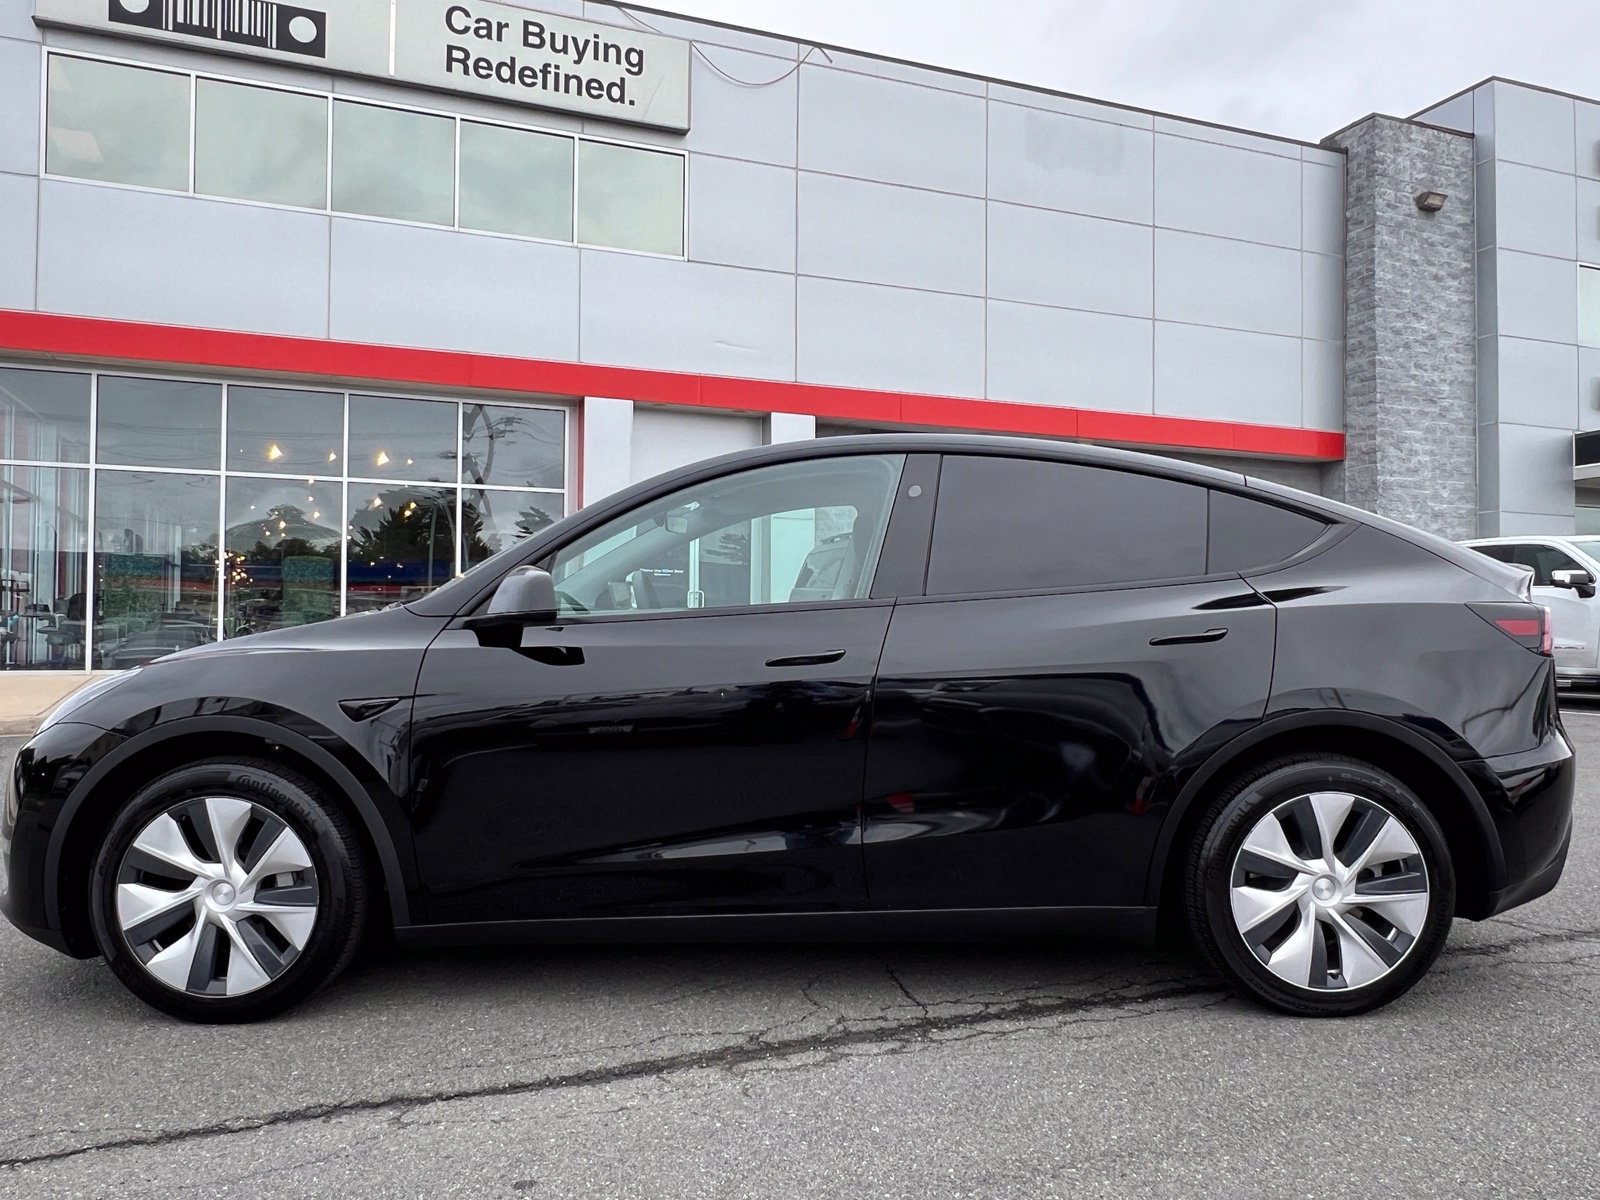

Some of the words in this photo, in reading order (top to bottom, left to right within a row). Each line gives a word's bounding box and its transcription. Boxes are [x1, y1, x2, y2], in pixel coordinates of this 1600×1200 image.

[445, 5, 510, 43] Car
[522, 19, 644, 77] Buying
[445, 44, 636, 106] Redefined.
[236, 774, 312, 819] Continental
